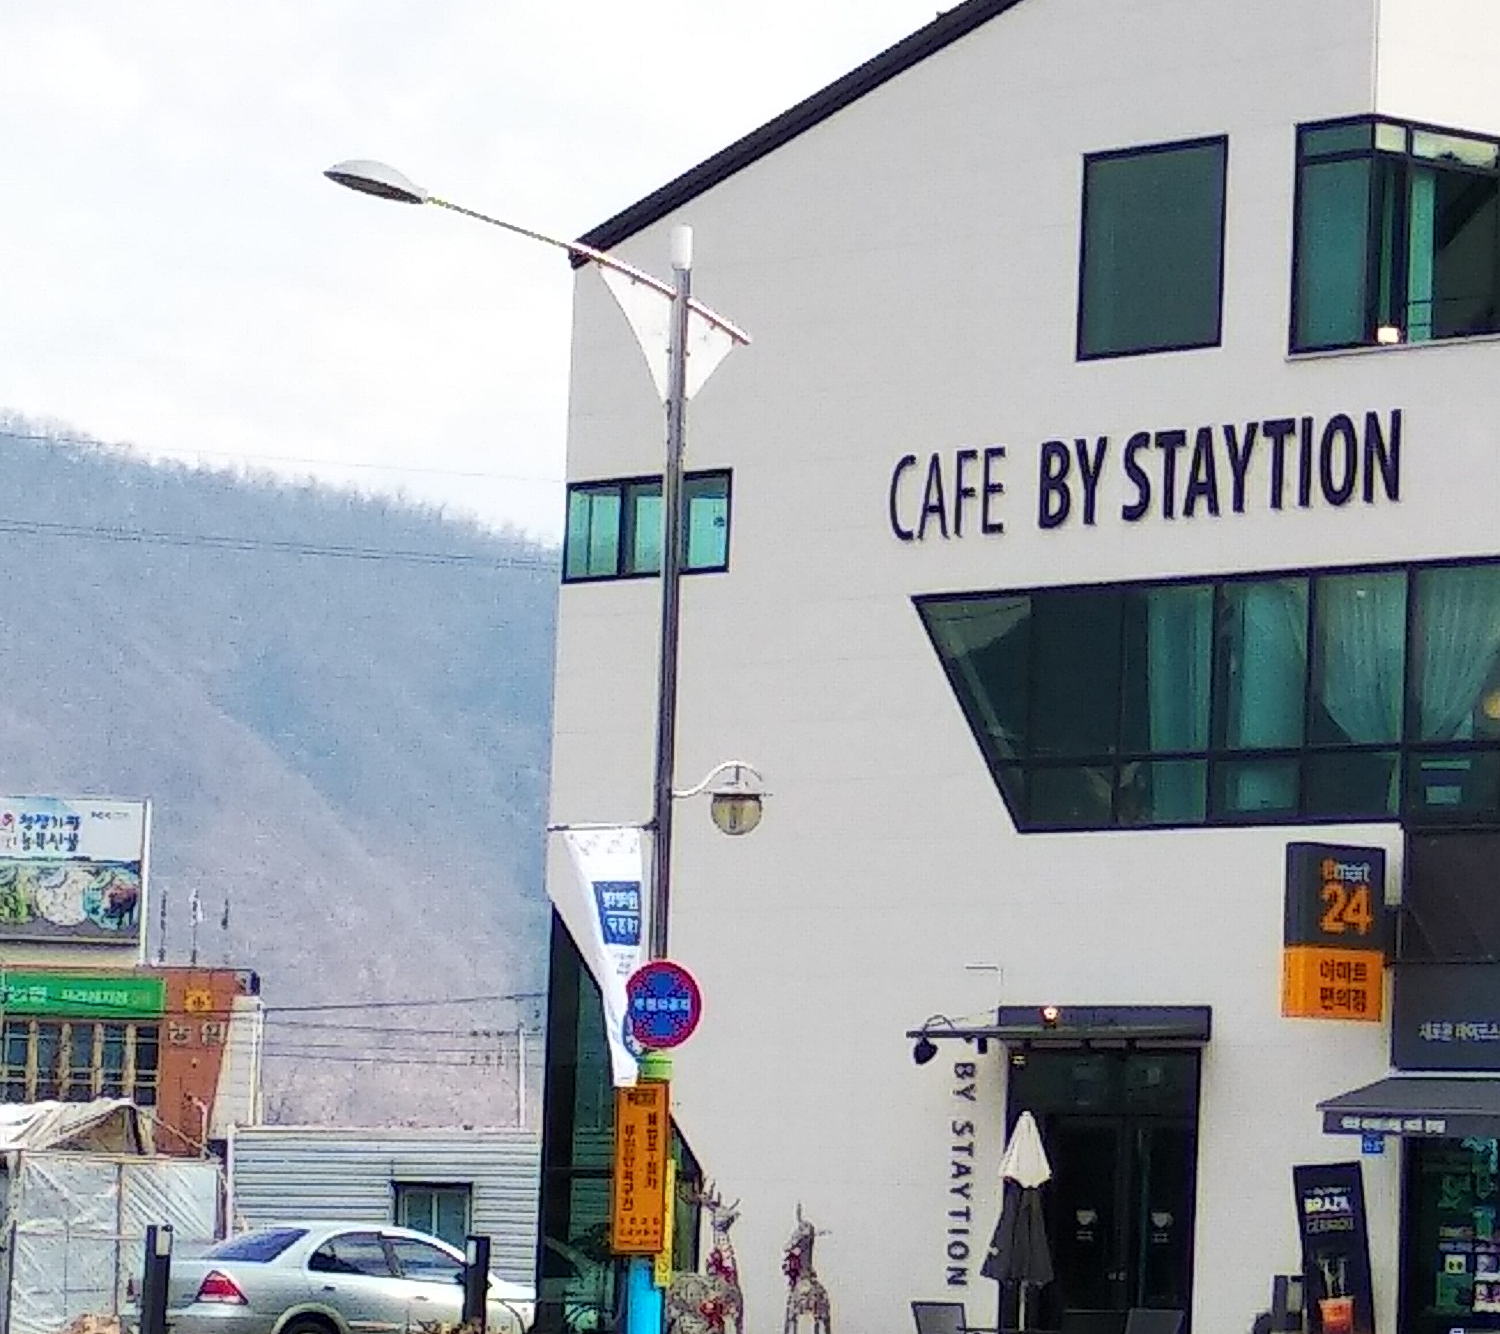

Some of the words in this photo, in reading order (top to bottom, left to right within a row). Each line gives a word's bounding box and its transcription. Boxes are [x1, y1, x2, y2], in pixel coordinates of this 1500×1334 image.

[889, 447, 1006, 541] CAFE
[1038, 436, 1108, 530] BY
[1121, 408, 1403, 523] STAYTION
[1320, 881, 1373, 935] 24
[1319, 959, 1367, 983] 이마트
[1319, 986, 1367, 1013] 편의점
[952, 1061, 977, 1102] BY
[946, 1120, 975, 1287] STAYTION
